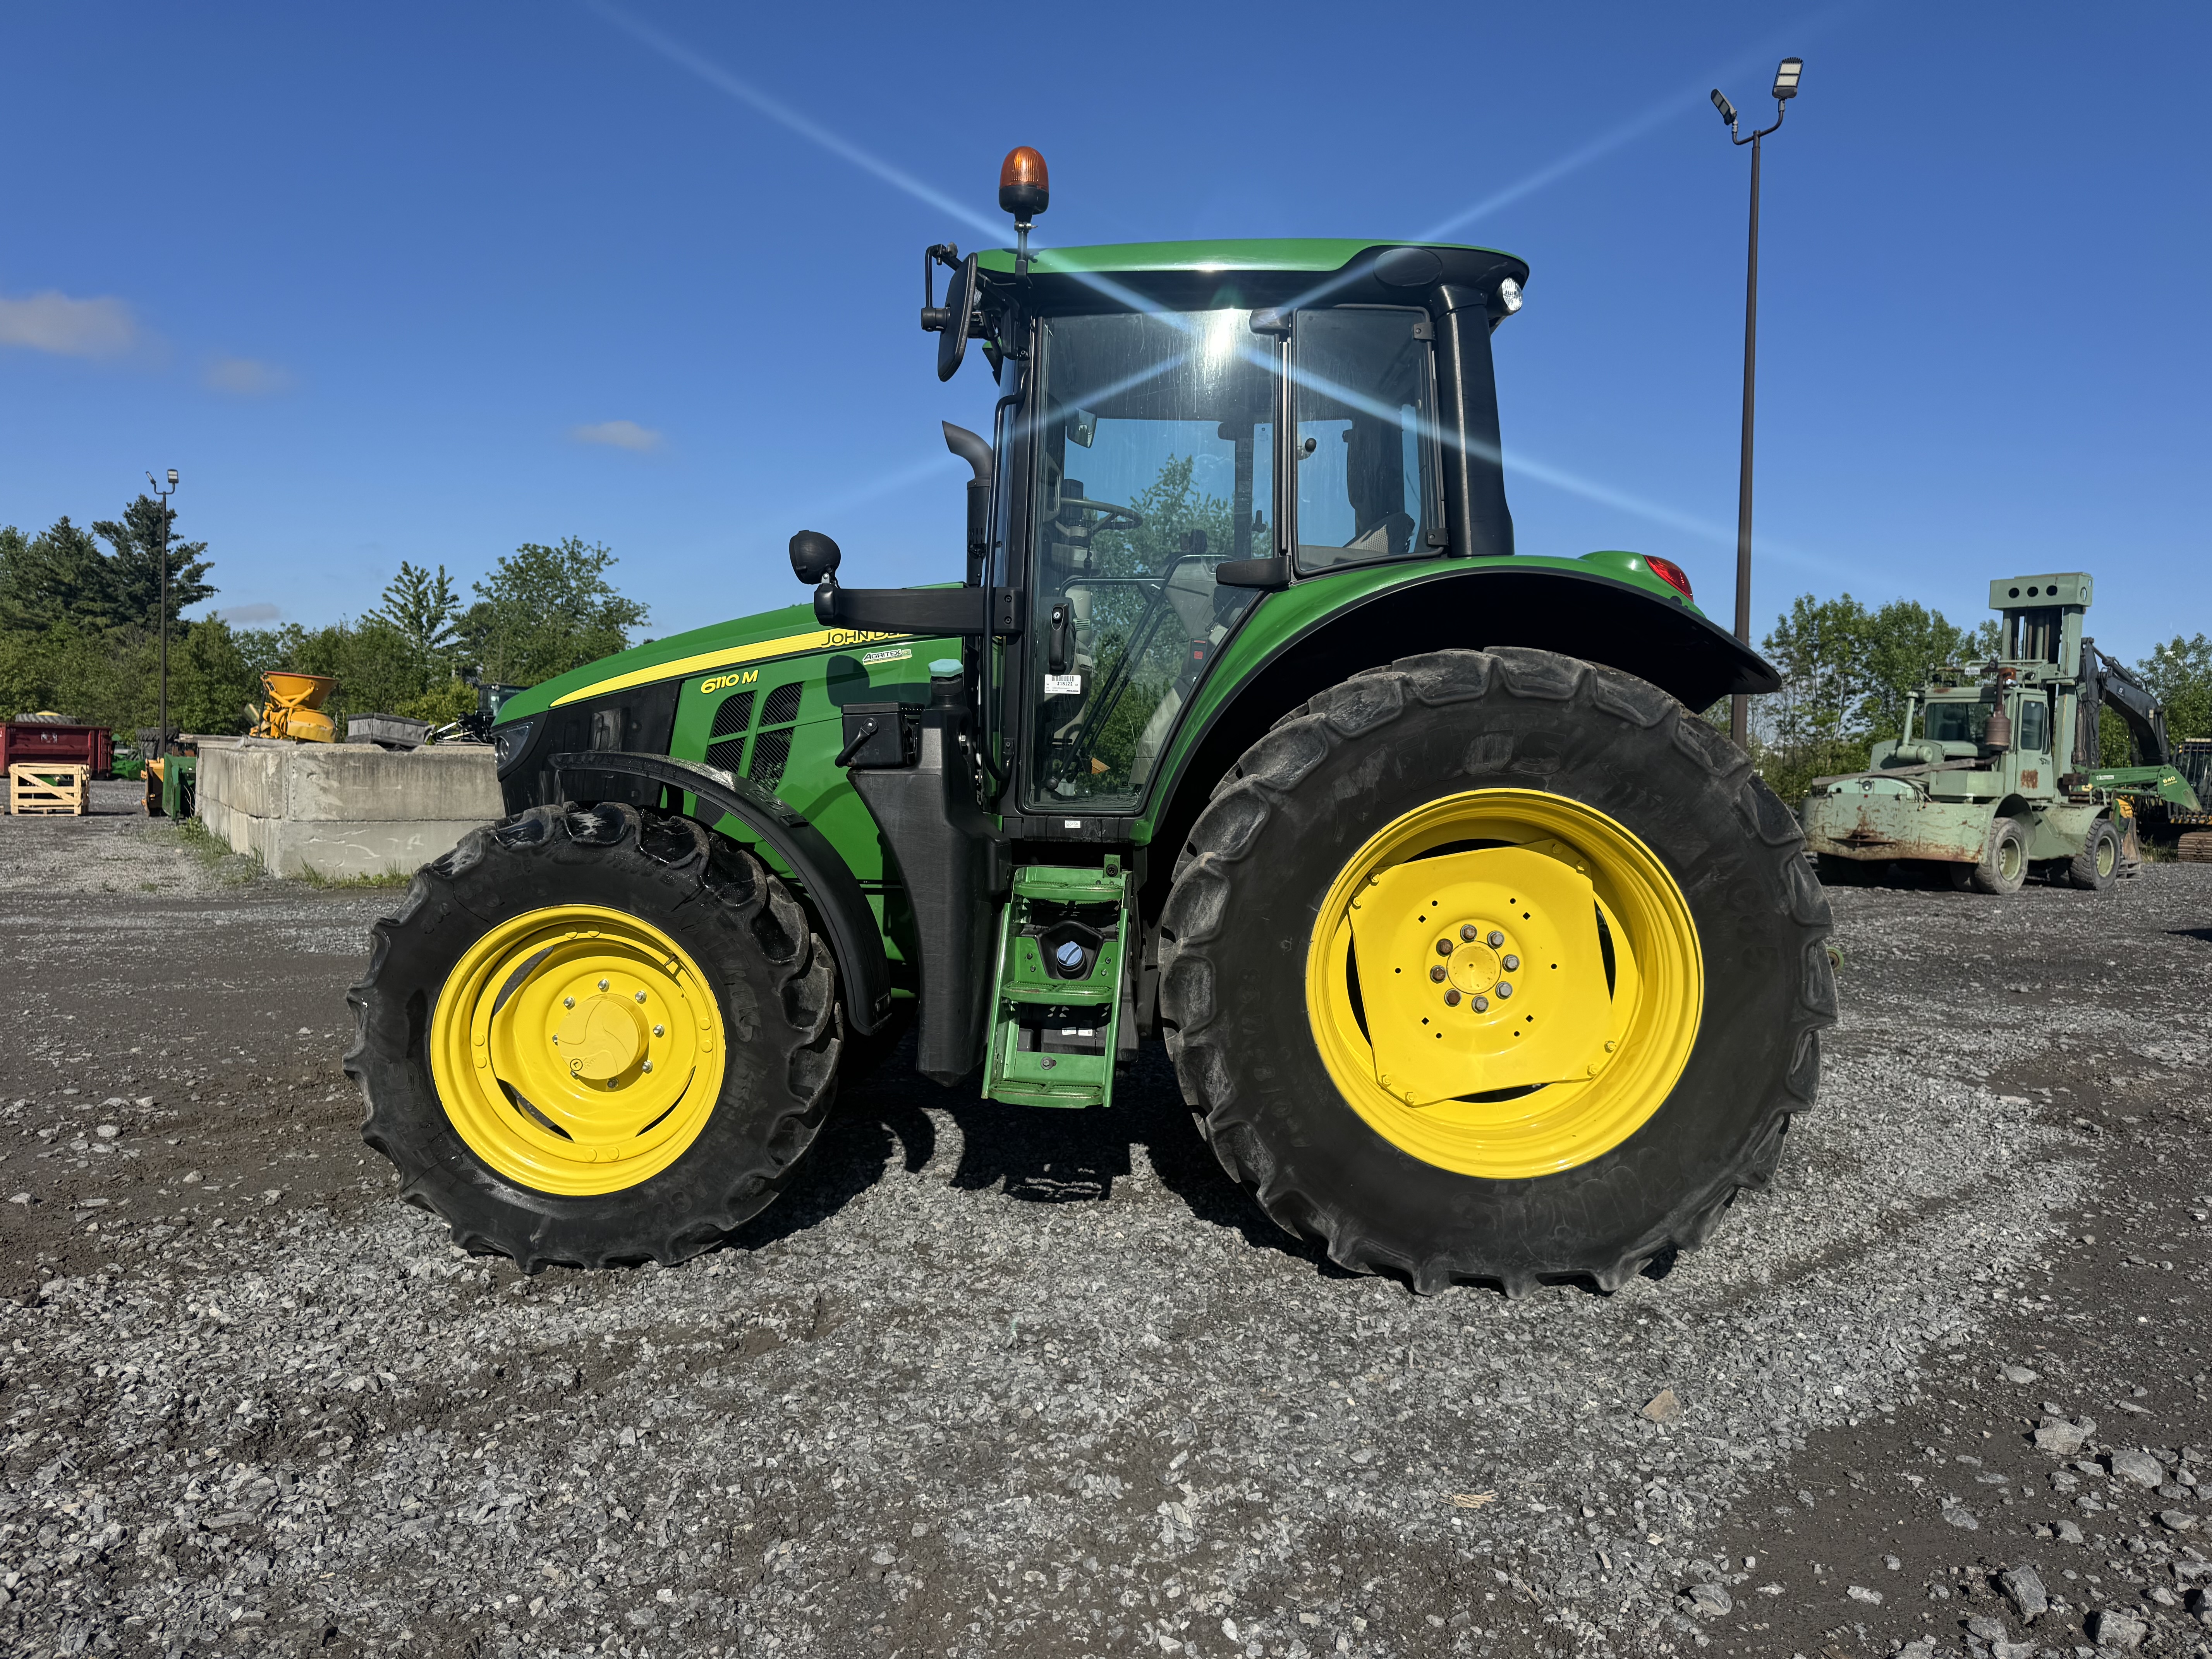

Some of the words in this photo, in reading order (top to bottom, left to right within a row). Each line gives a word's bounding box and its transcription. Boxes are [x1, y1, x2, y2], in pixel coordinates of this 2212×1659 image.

[821, 631, 869, 646] JOHN
[864, 650, 901, 660] AGRITEX
[701, 674, 739, 694] 6110
[742, 670, 759, 684] M
[1332, 725, 1566, 847] Mitas
